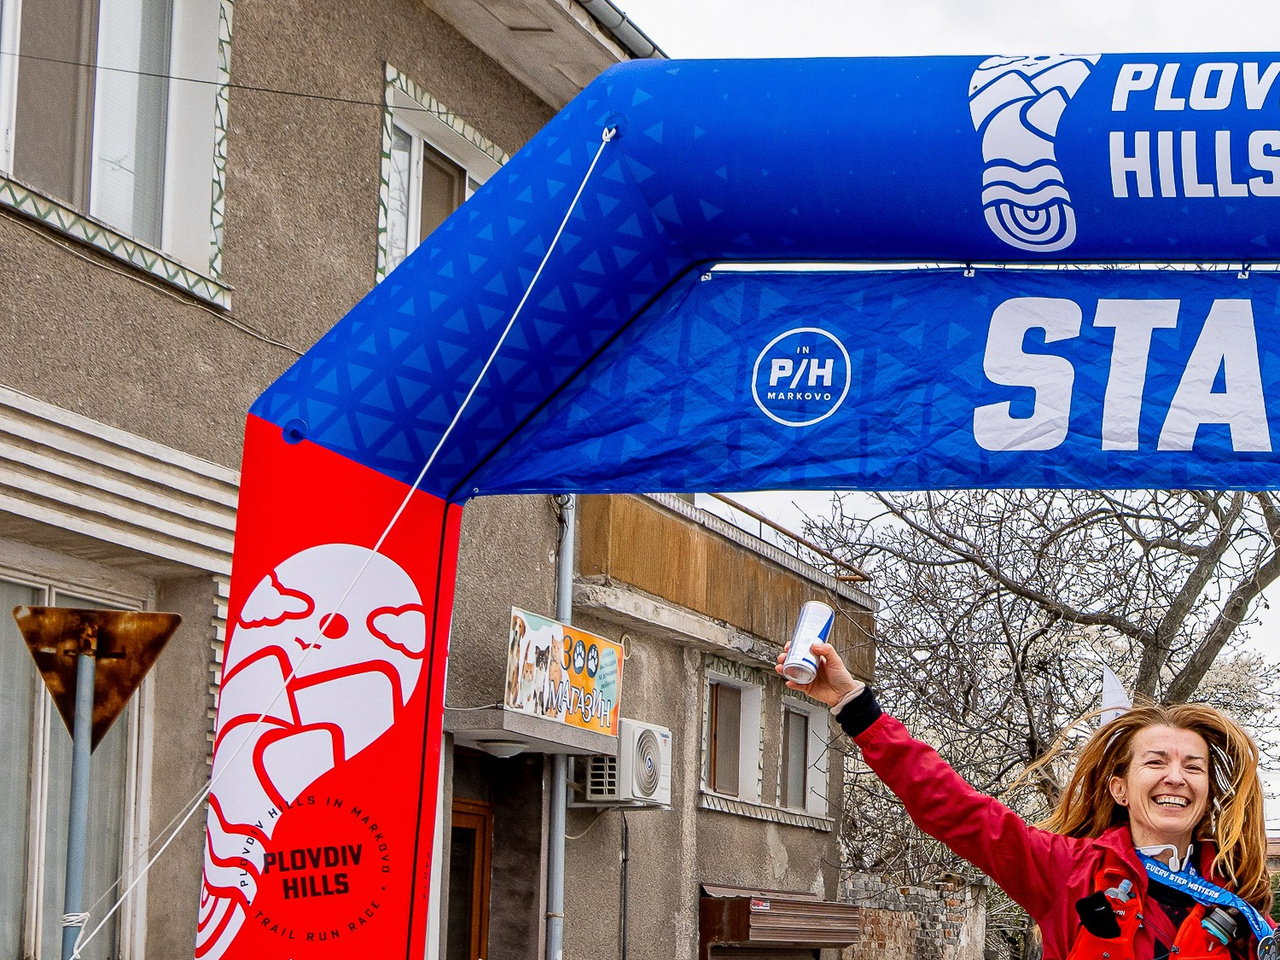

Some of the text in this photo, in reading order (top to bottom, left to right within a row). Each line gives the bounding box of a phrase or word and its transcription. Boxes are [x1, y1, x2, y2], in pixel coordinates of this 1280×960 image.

[797, 346, 810, 354] IN
[769, 358, 834, 389] P/H
[767, 392, 831, 401] MARKOVO
[549, 679, 611, 728] МАГАЗИН
[239, 795, 390, 887] PLOVDIV HILLS IN MARKOVO
[263, 844, 363, 874] PLOVDIV
[283, 873, 350, 899] HILLS
[1145, 862, 1170, 879] EVERY
[1168, 872, 1187, 886] STEP
[1187, 881, 1221, 899] MATTERS
[254, 900, 381, 942] TRAIL RUN RACE
